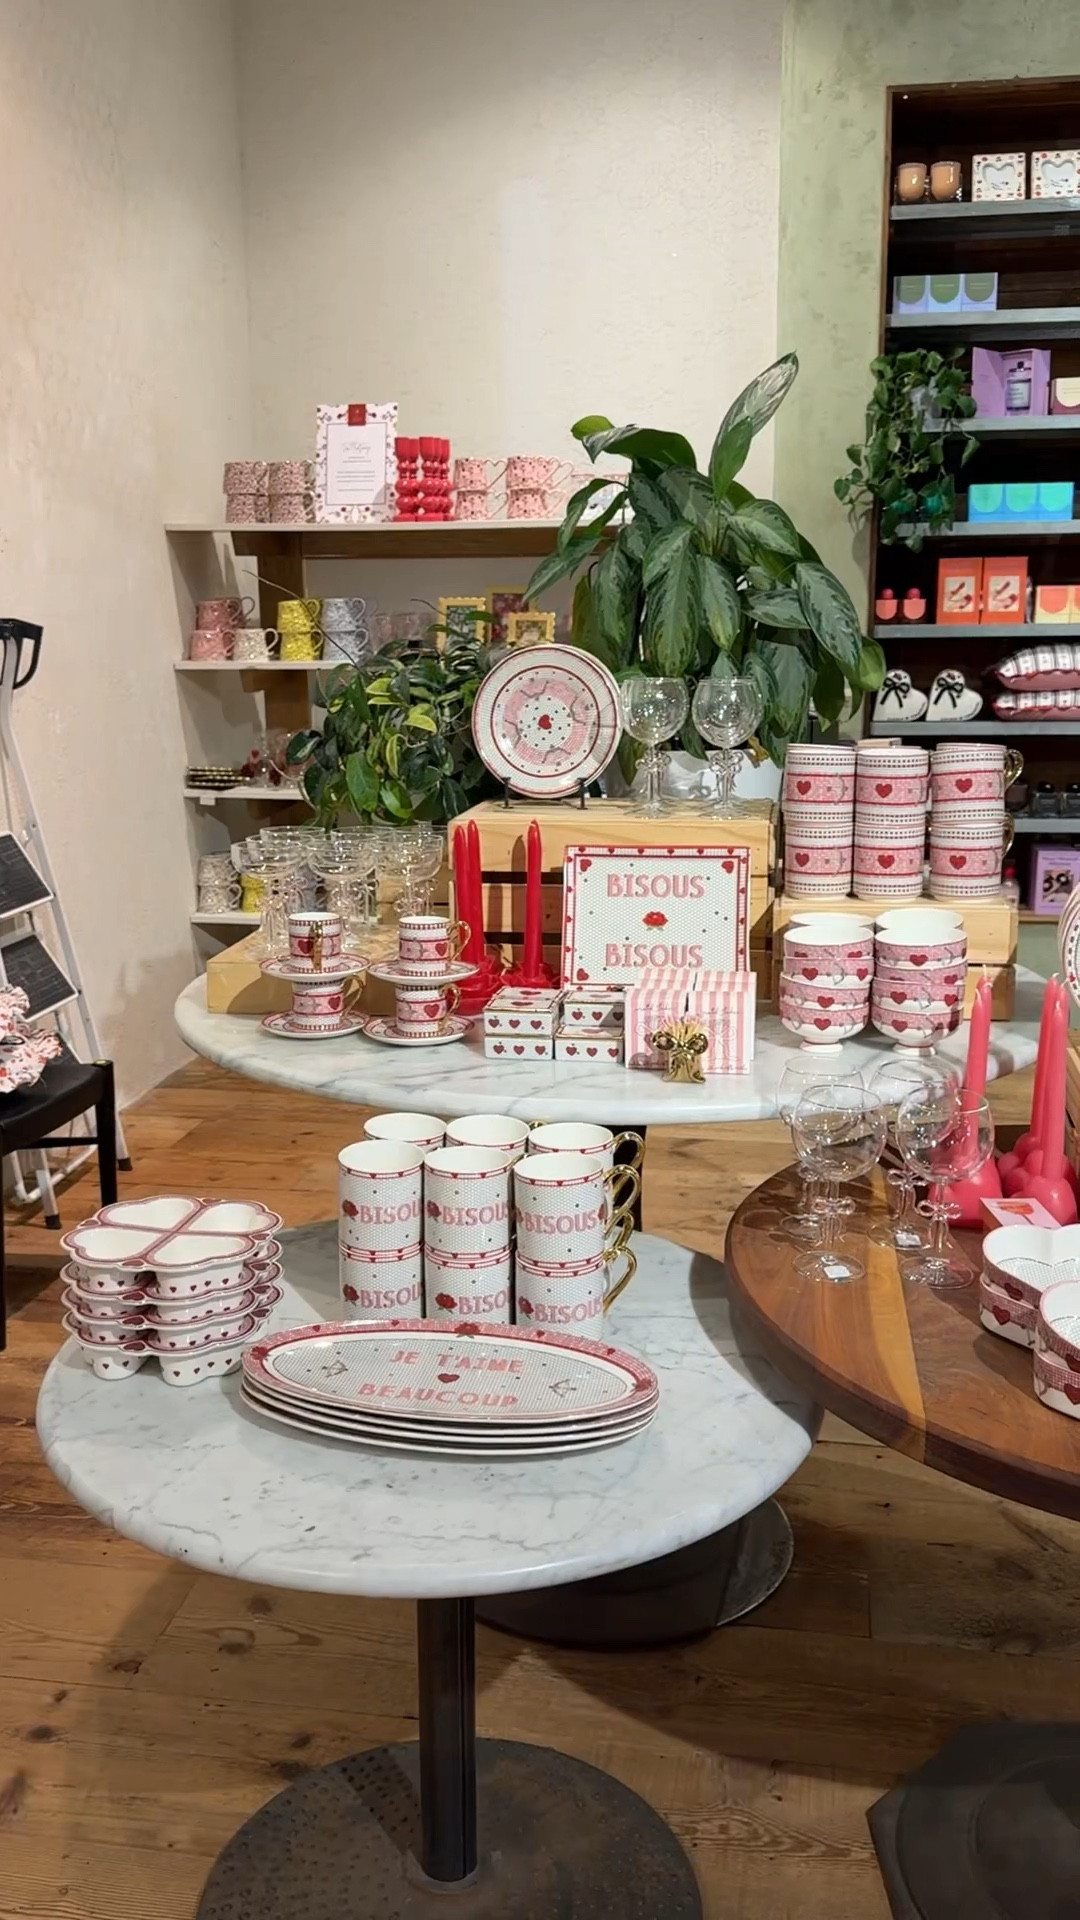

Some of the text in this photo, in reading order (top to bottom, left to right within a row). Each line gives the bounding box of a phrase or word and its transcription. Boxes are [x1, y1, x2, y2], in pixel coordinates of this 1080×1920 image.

[607, 873, 704, 898] BISOUS
[605, 943, 703, 968] BISOUS
[525, 1209, 596, 1234] BISOUS
[458, 1288, 510, 1315] BISO
[389, 1350, 523, 1374] JE T'AIME
[357, 1382, 519, 1407] BEAUCOUP
